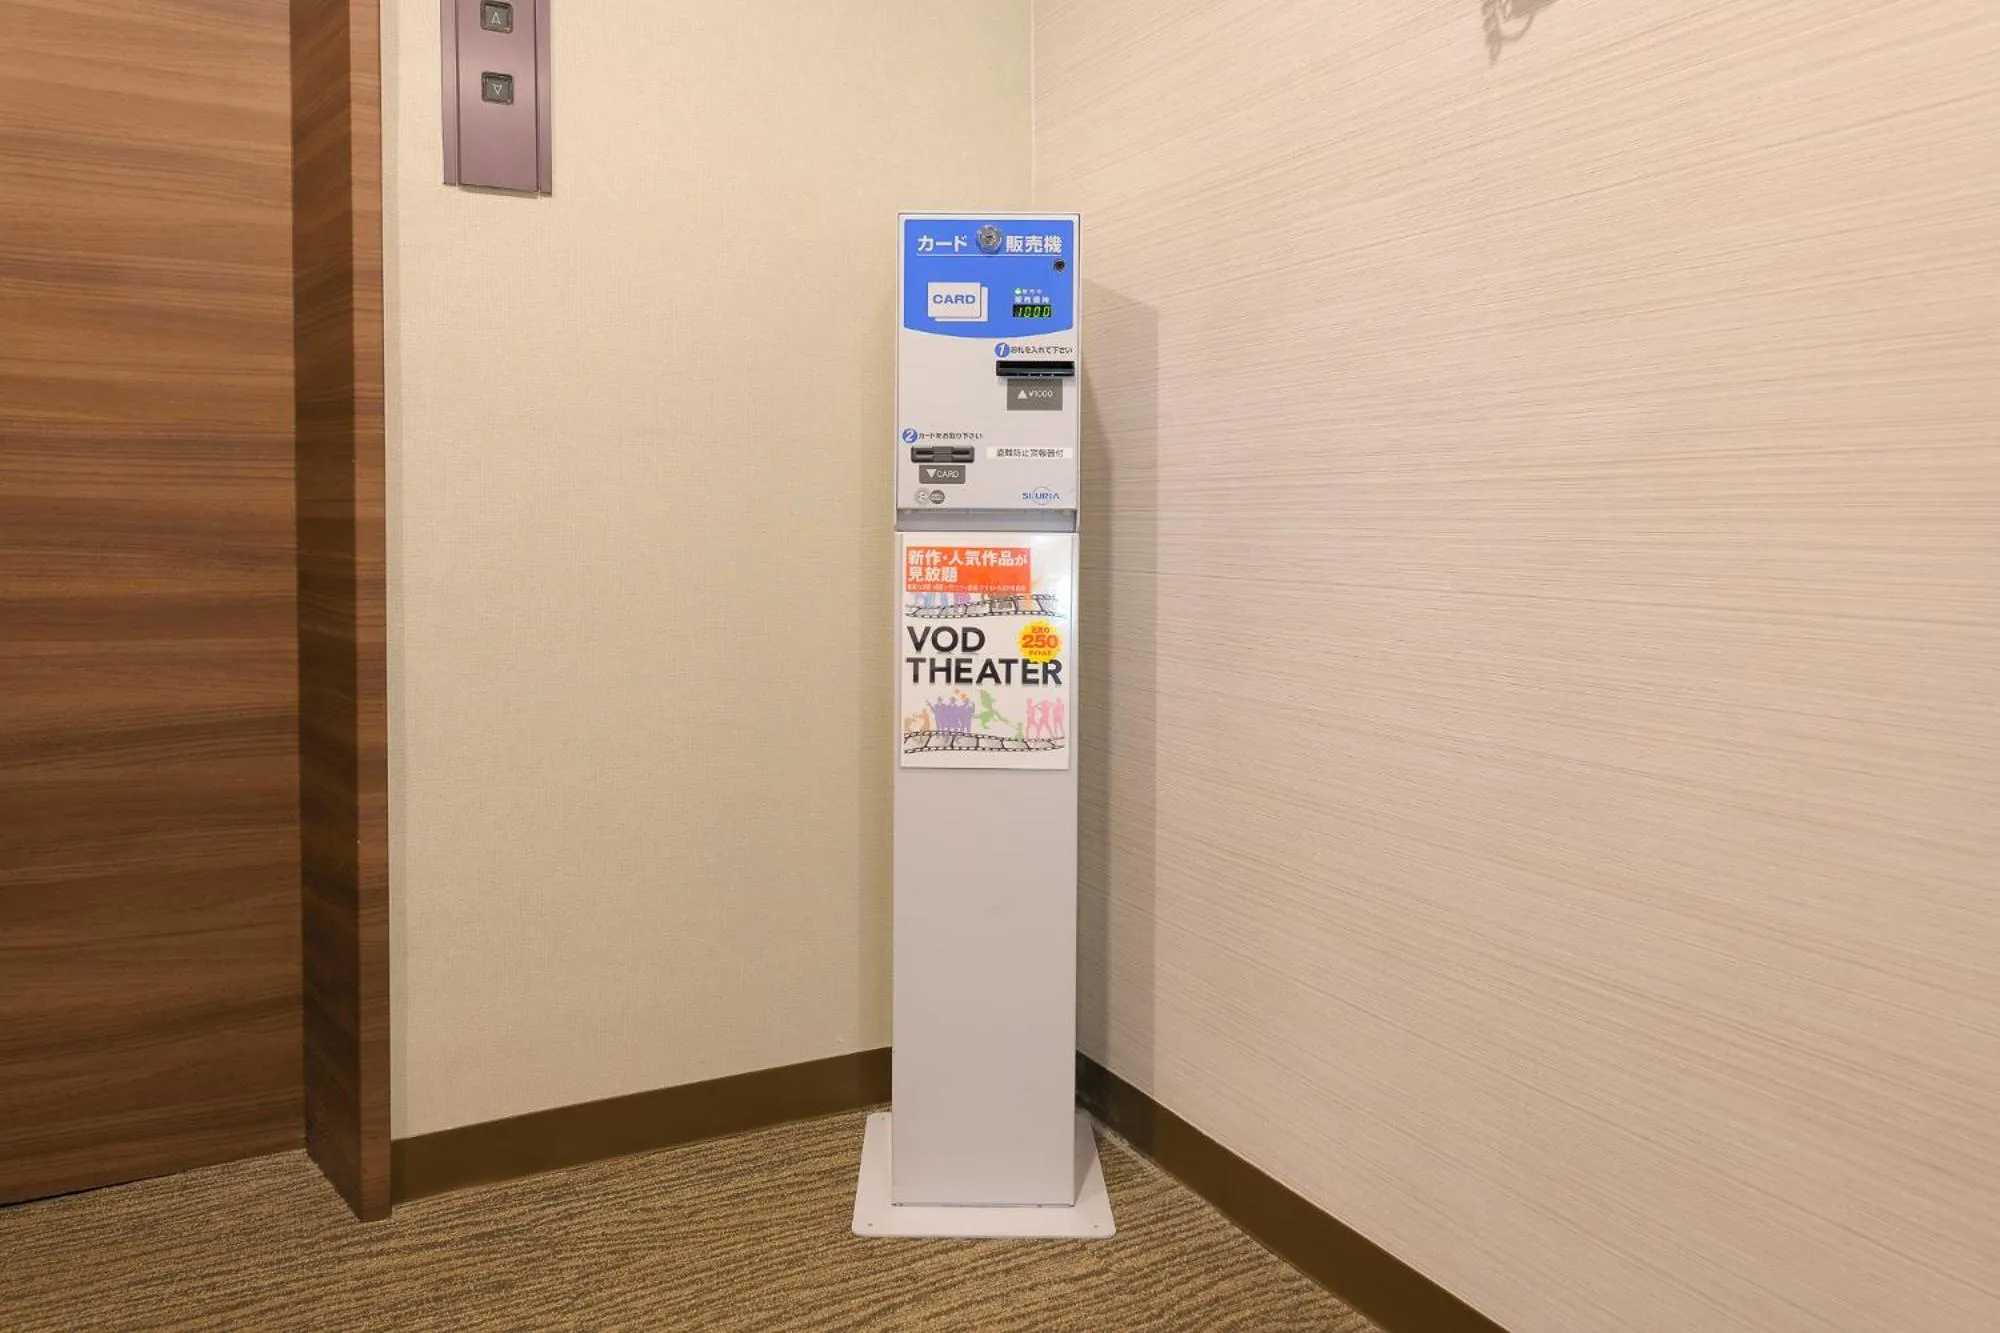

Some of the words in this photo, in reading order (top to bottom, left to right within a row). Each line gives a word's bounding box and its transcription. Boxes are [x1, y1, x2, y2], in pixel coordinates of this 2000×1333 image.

[917, 235, 968, 252] カード
[1005, 235, 1063, 253] 販売機
[932, 294, 976, 305] CARD
[1017, 306, 1051, 318] 1000
[936, 470, 960, 478] CARD
[908, 550, 1027, 566] 新作・人気作品が
[908, 566, 958, 582] 見放題
[907, 626, 985, 653] VOD
[1021, 635, 1059, 649] 250
[906, 657, 1063, 685] THEATER
